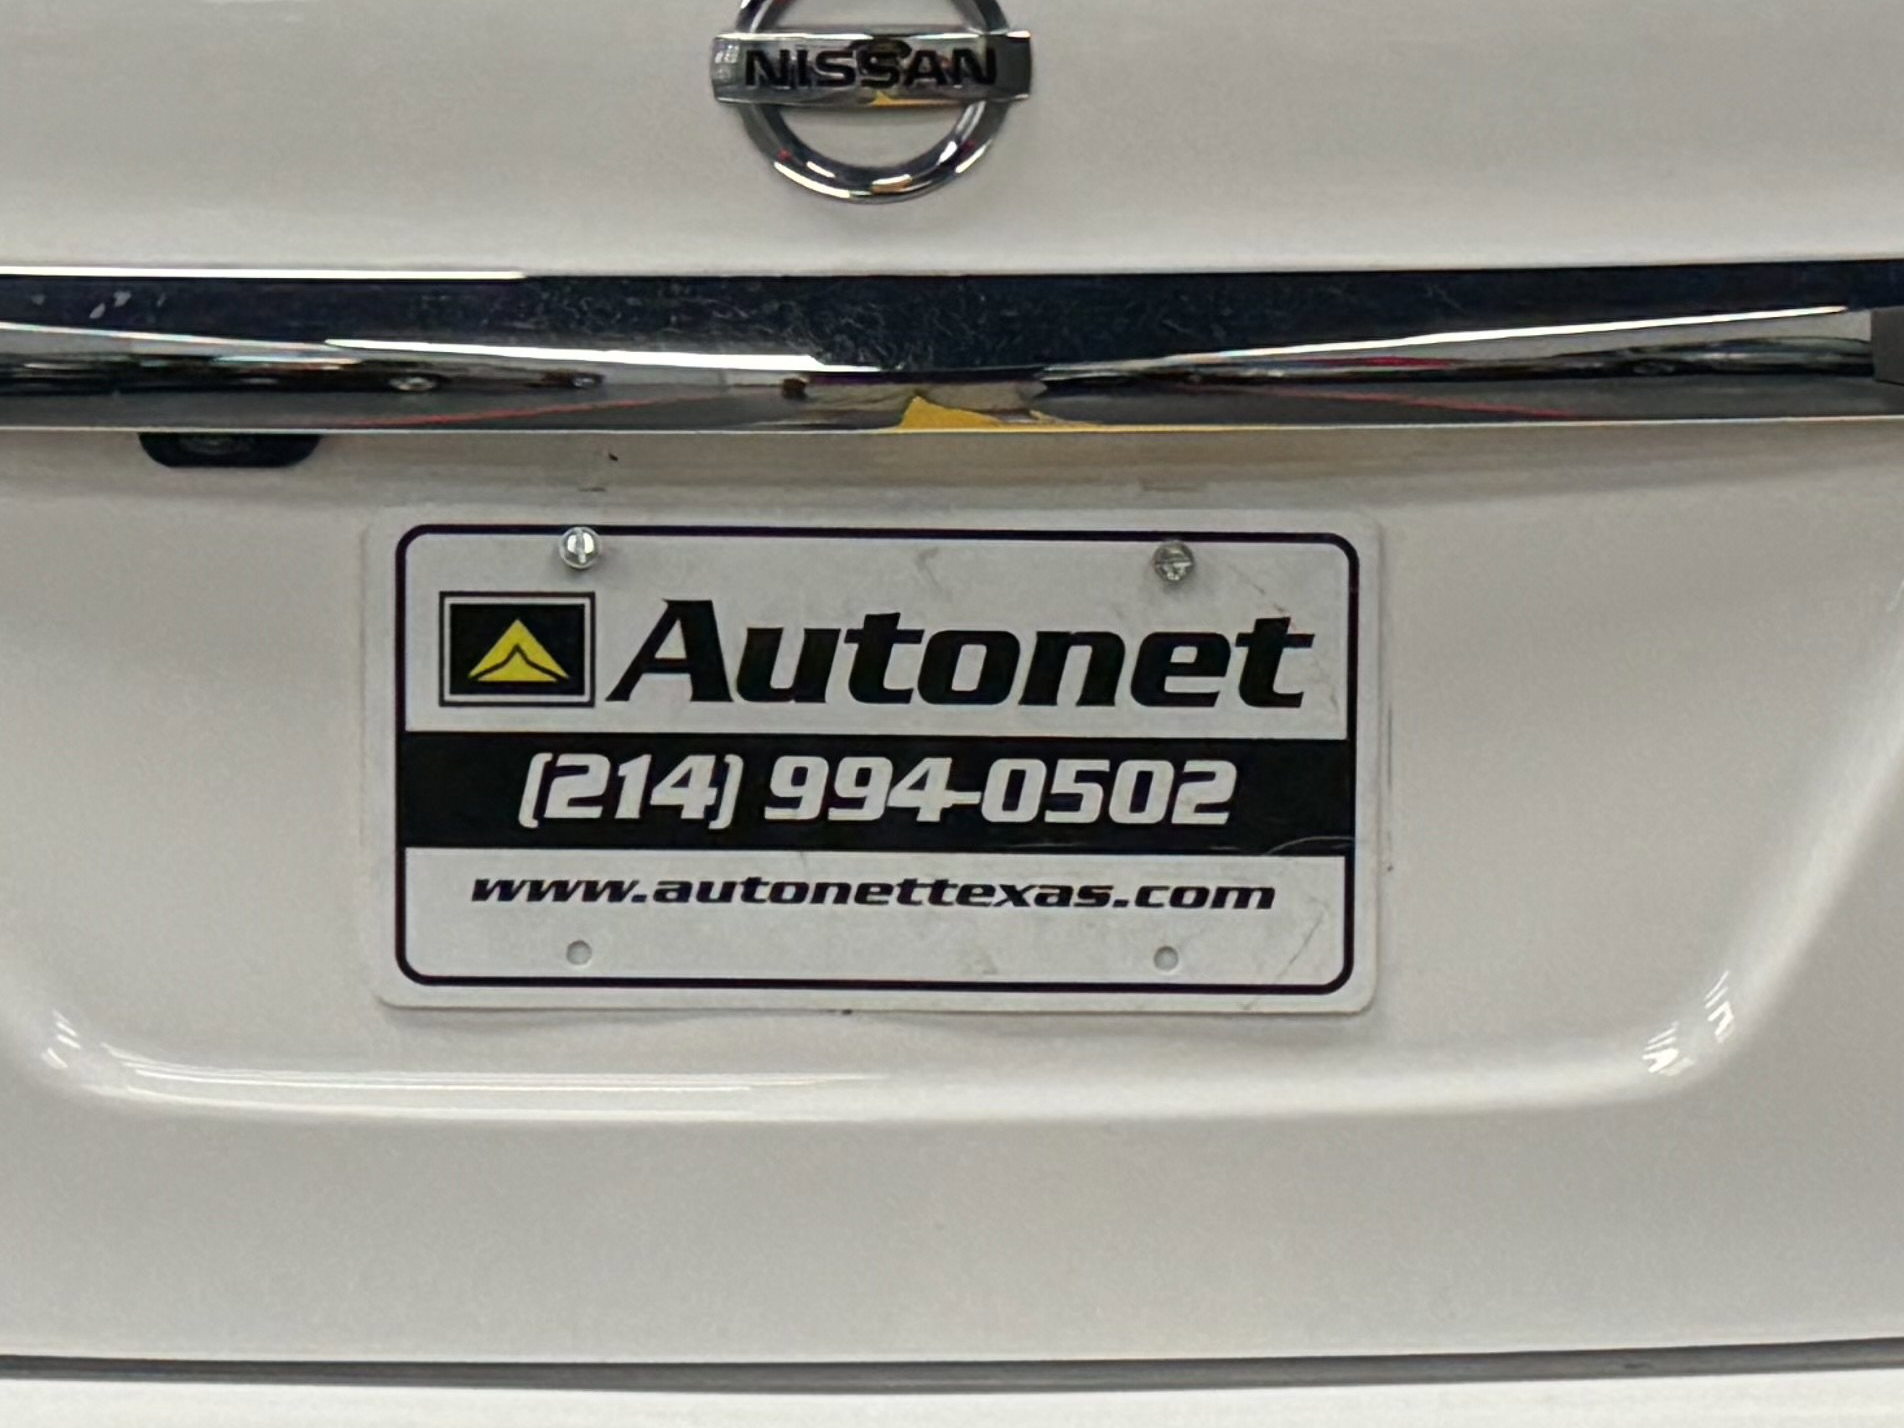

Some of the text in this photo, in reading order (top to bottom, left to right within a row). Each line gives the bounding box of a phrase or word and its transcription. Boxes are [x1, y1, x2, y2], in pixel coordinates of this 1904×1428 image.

[744, 48, 997, 88] NISSAN
[604, 598, 1316, 709] Autonet
[518, 752, 1237, 830] (214) 994-0502
[471, 876, 1276, 910] www.autonettexas.com
